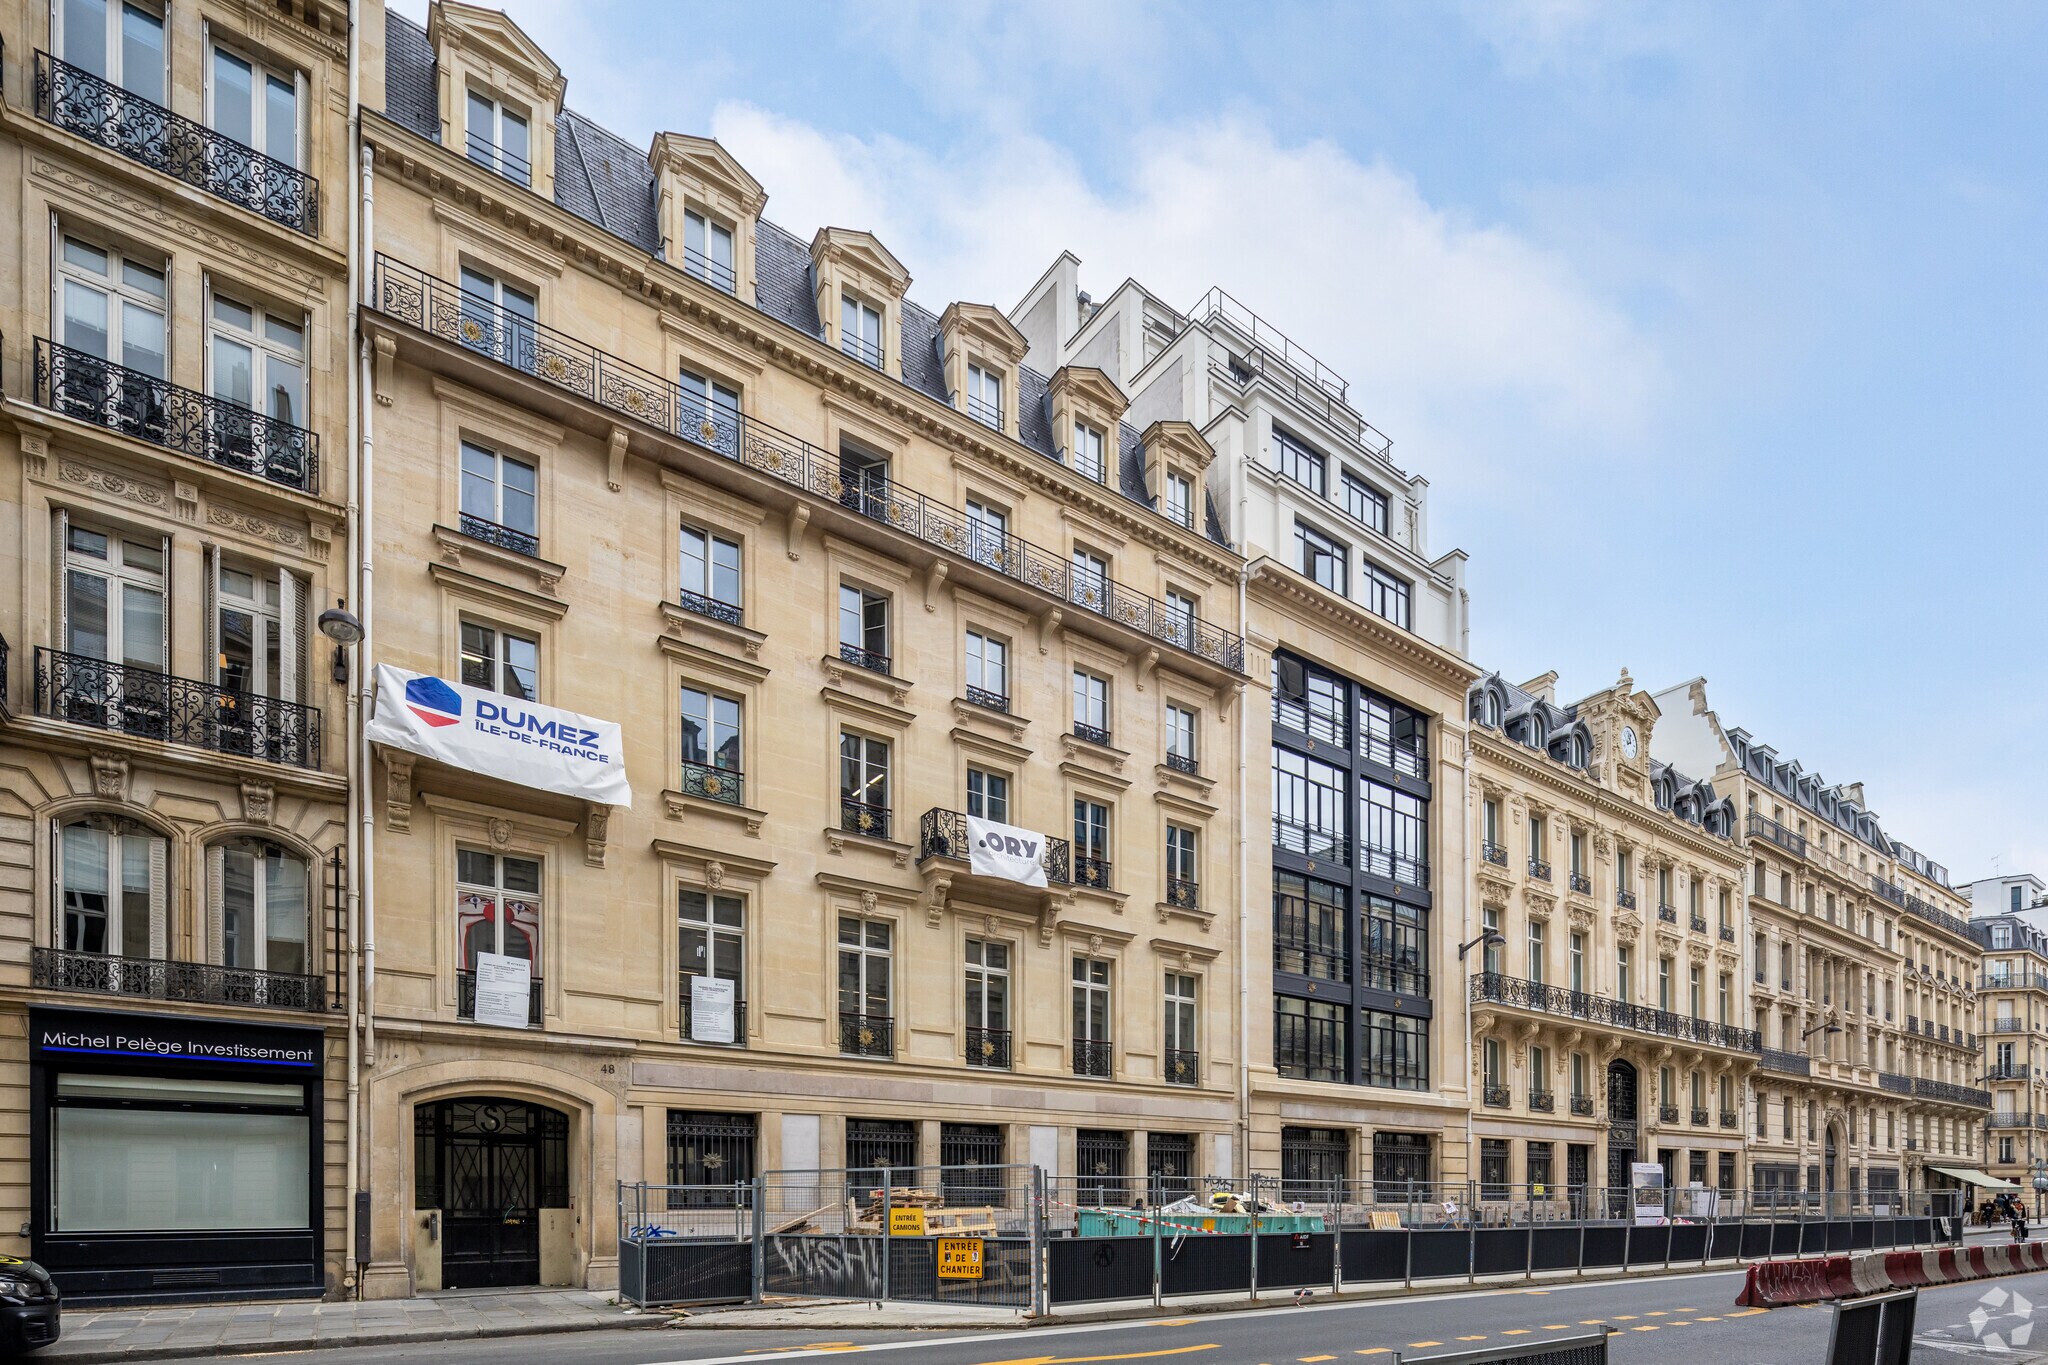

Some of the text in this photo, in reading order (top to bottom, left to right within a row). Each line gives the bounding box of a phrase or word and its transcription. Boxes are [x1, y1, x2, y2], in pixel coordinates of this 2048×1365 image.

[476, 699, 599, 749] DUMEZ
[475, 719, 609, 763] ÎLE-DE-FRANCE
[43, 1031, 313, 1060] Michel Pelège Investissement
[600, 1064, 615, 1074] 48
[895, 1213, 916, 1222] ENTRÉE
[944, 1240, 978, 1251] ENTRÉE
[955, 1254, 966, 1262] DE
[940, 1265, 980, 1274] CHANTIER
